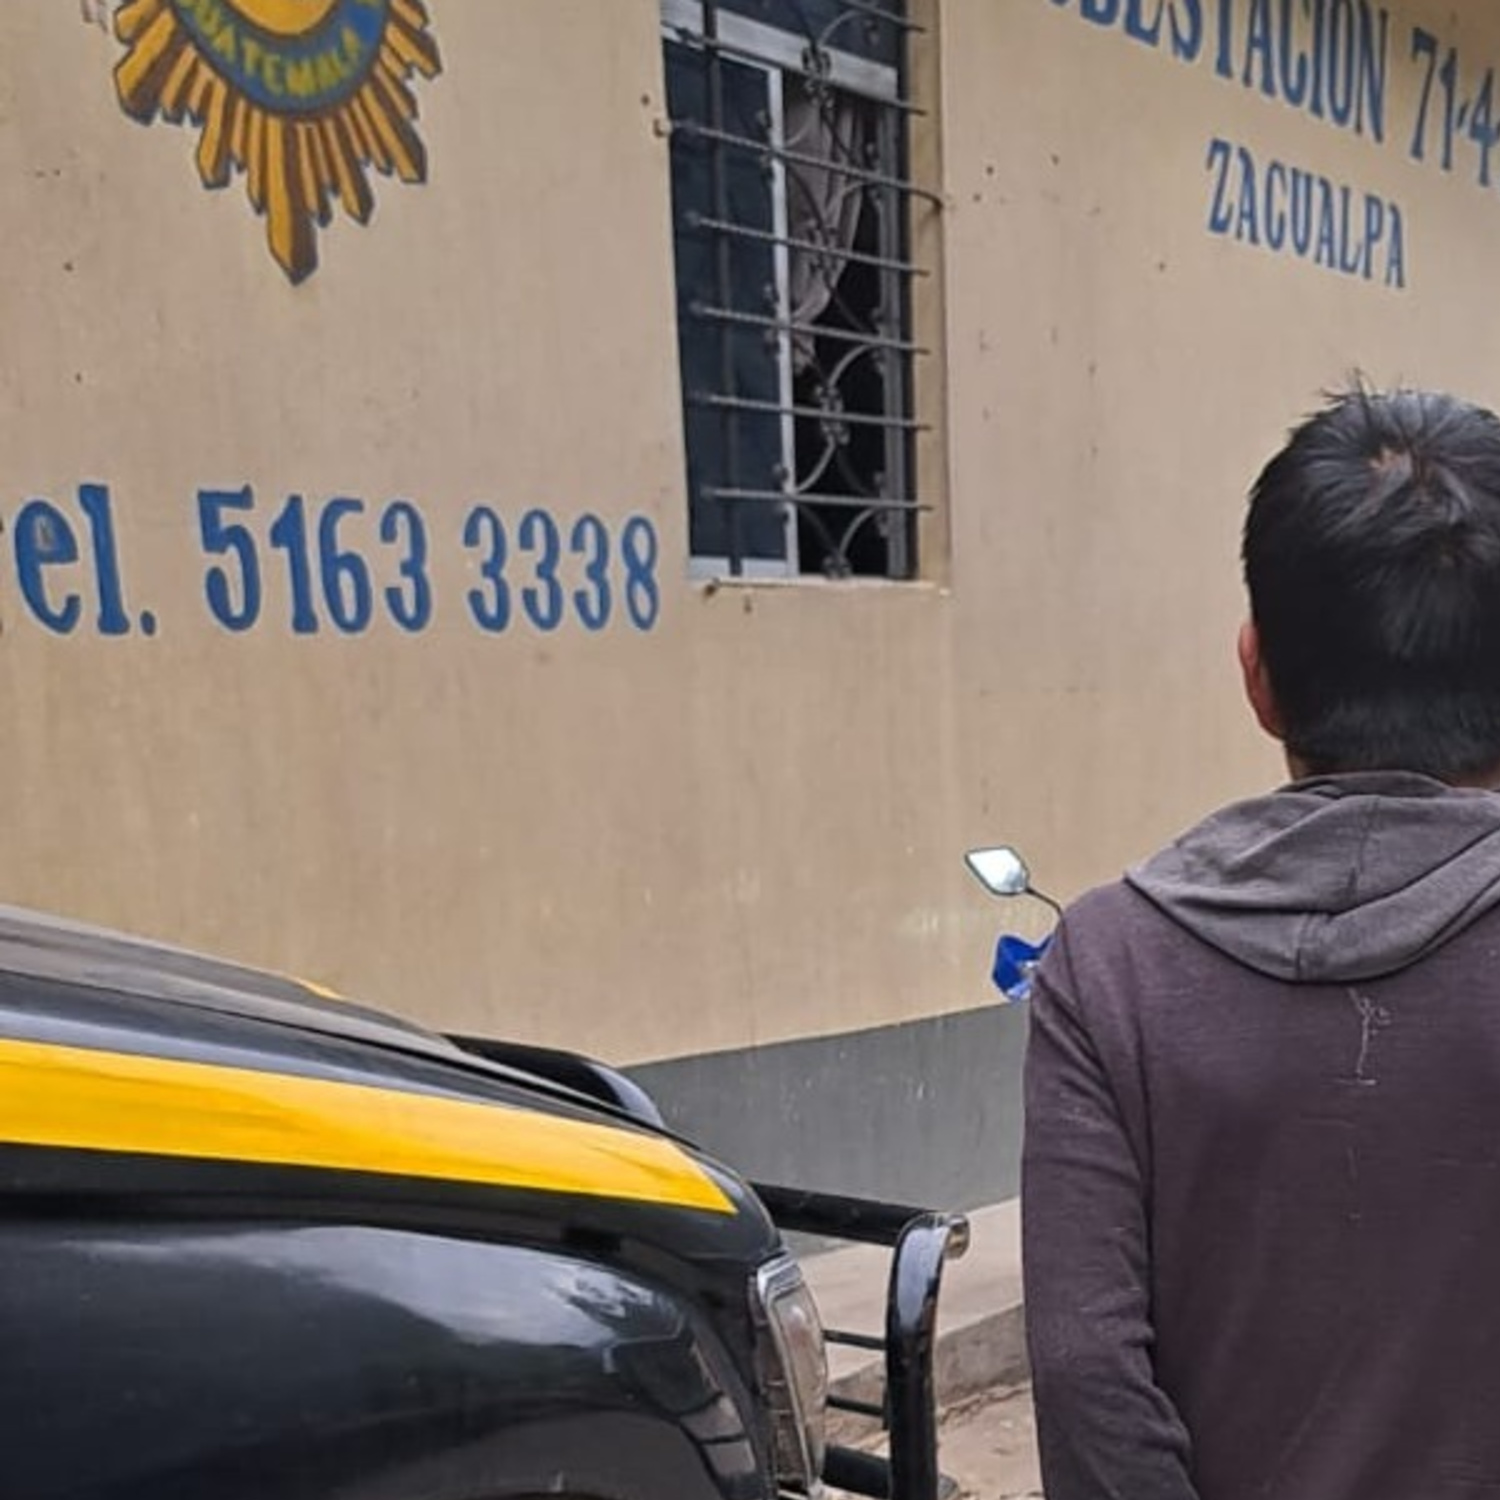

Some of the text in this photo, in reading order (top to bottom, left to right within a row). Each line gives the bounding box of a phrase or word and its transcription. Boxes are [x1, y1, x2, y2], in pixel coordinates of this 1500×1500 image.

[1207, 138, 1405, 288] ZACUALPA
[0, 484, 660, 636] el. 5163 3338
